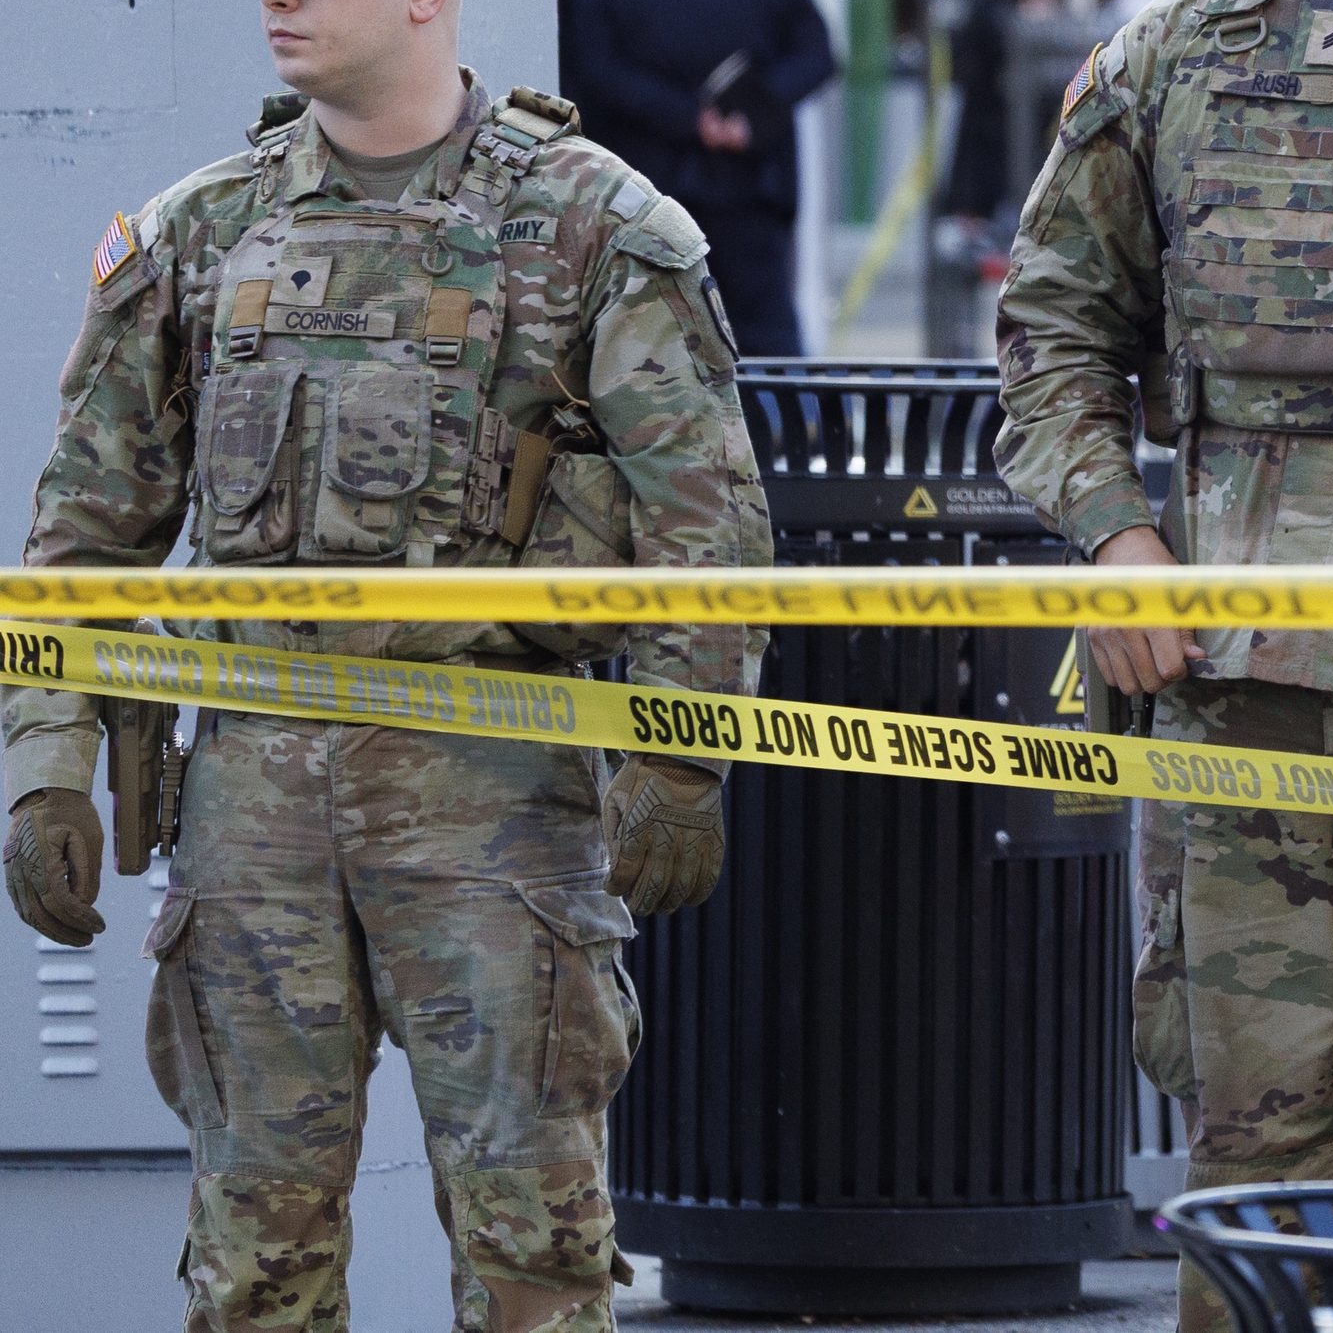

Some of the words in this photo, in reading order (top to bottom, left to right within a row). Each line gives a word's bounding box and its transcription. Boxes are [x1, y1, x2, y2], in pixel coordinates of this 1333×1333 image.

[1251, 73, 1301, 96] RUSH
[500, 220, 546, 242] RMY
[285, 310, 369, 333] CORNISH
[946, 487, 1009, 504] GOLDEN
[94, 640, 202, 696] CROSS
[216, 652, 279, 704] NOT
[291, 660, 336, 711] DO
[347, 666, 455, 723] SCENE
[467, 676, 576, 734] CRIME
[629, 695, 742, 751] CROSS
[754, 707, 820, 757] NOT
[828, 715, 876, 763] DO
[884, 722, 996, 775] SCENE
[1001, 734, 1119, 786] CRIME
[1146, 749, 1261, 800] CROSS
